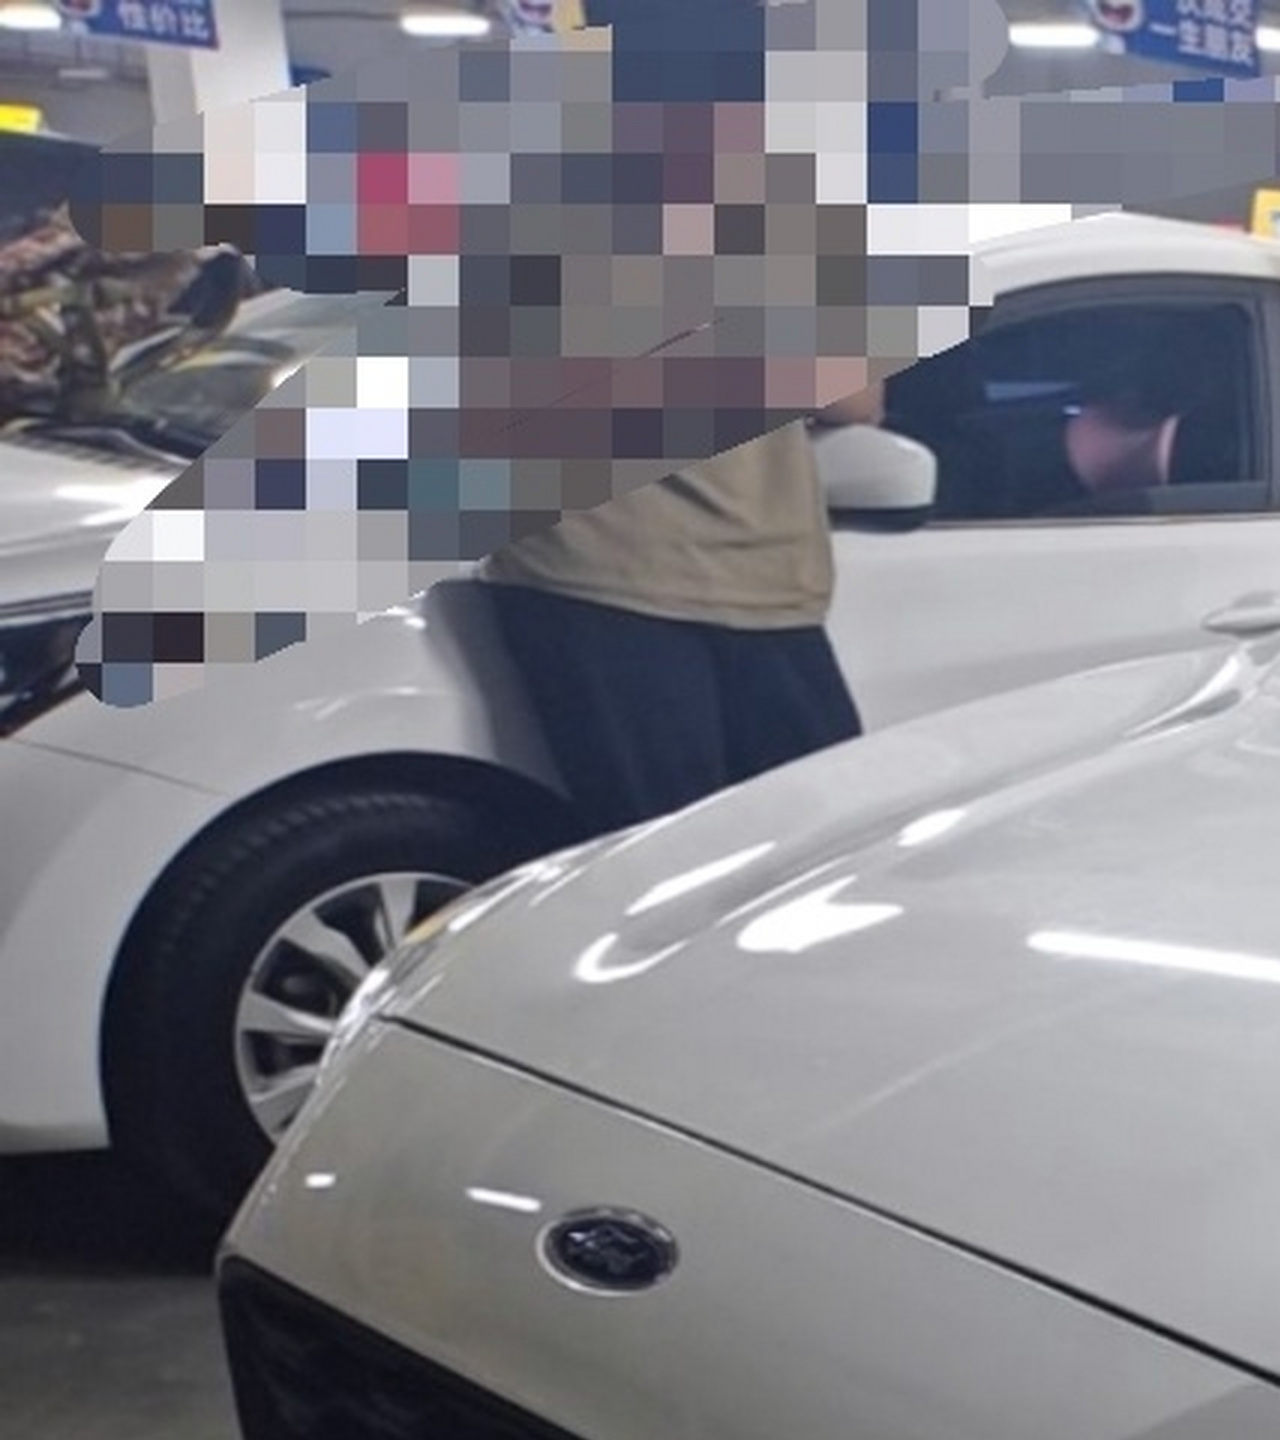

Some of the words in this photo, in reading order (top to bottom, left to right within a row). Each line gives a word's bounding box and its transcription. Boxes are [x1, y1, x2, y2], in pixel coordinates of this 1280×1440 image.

[117, 2, 210, 40] 性价比
[1149, 19, 1255, 67] 一生朋友
